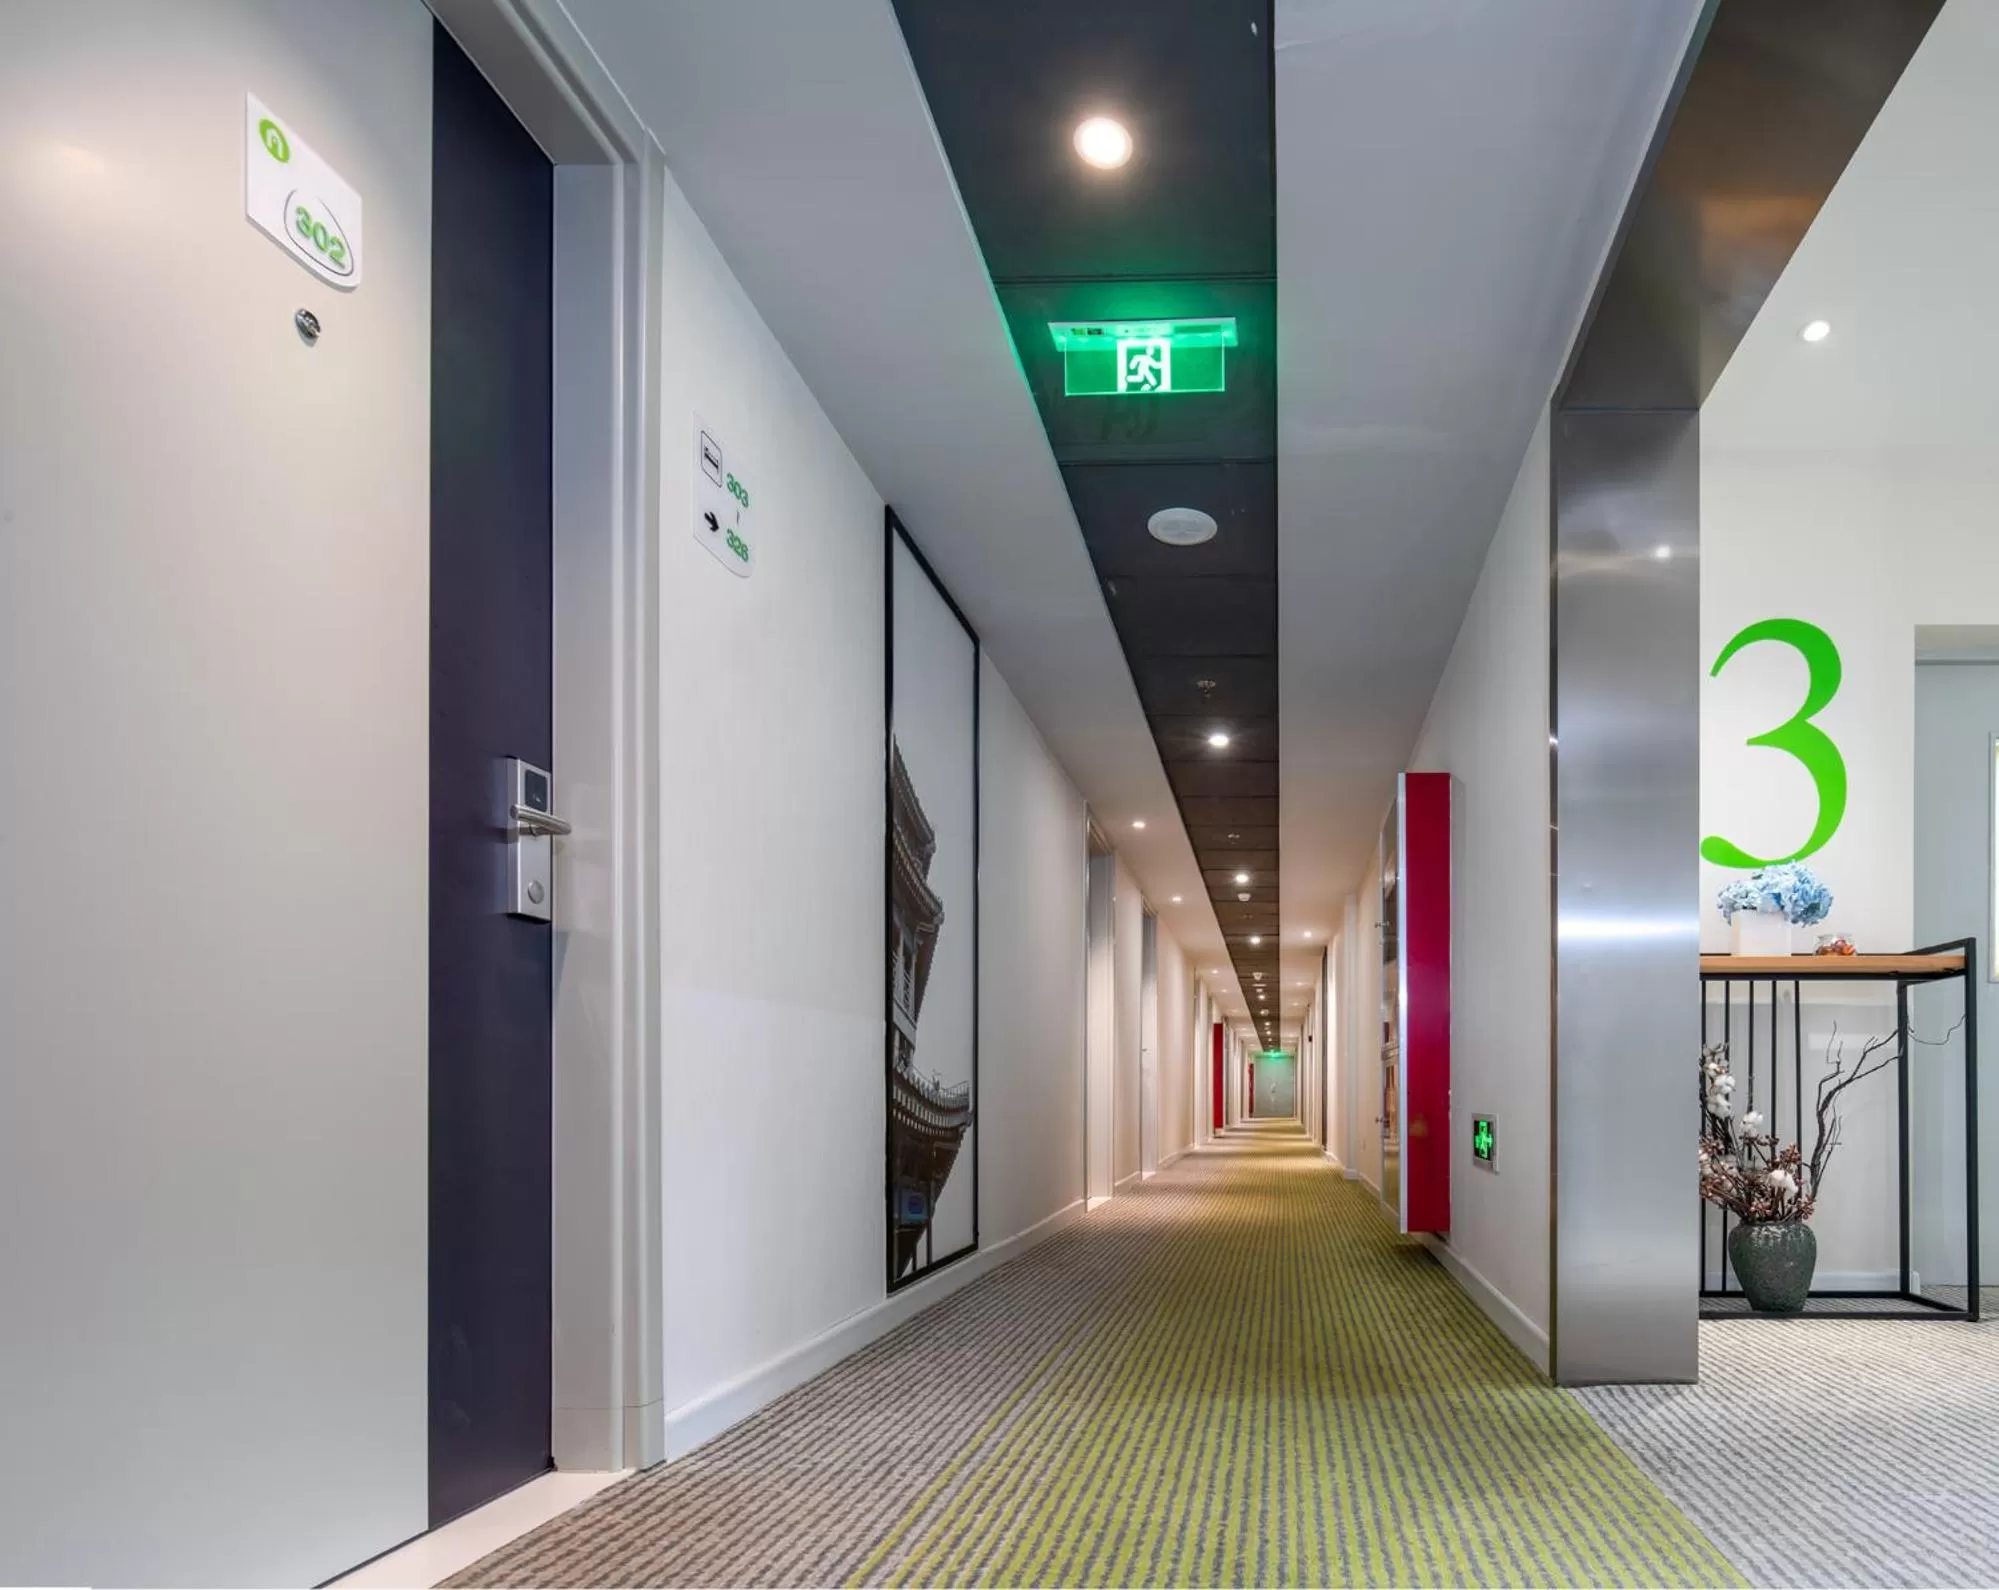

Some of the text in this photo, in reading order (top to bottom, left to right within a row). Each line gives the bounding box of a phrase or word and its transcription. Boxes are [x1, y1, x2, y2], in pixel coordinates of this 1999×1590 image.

[296, 206, 346, 270] 302
[726, 472, 749, 508] 303
[1700, 618, 1847, 869] 3
